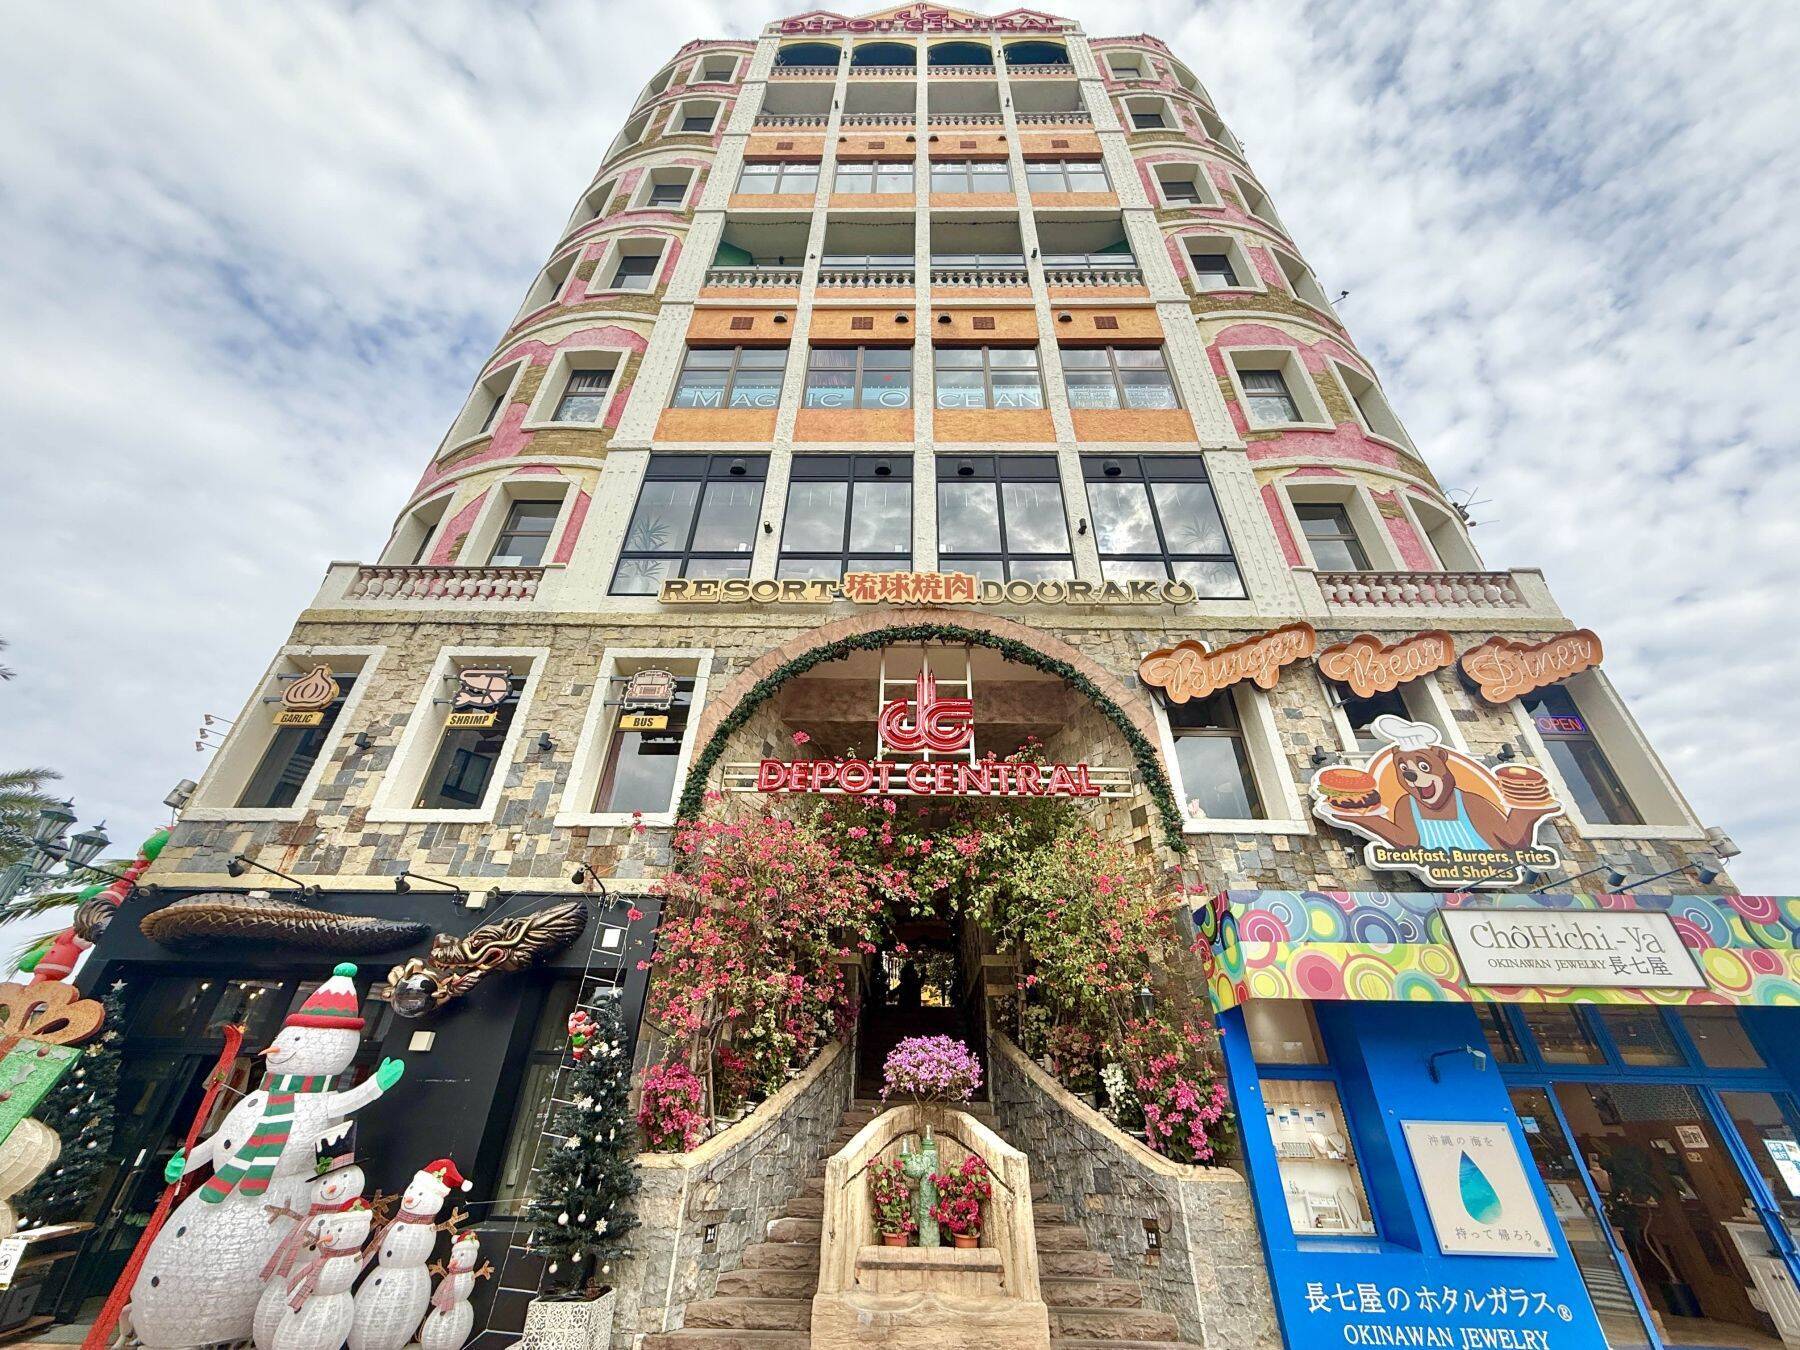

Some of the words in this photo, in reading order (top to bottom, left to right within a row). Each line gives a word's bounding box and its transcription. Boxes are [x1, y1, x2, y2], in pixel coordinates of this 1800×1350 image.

[781, 19, 895, 33] DEPOT
[904, 18, 1063, 33] CENTRAL
[691, 390, 843, 407] MAGIC
[879, 390, 1042, 408] OCEAN
[662, 580, 837, 601] RESORT
[845, 573, 975, 600] 琉球焼肉
[1149, 630, 1305, 693] Burger
[1328, 639, 1445, 688] Bear
[1471, 639, 1592, 696] Diner
[279, 714, 314, 724] GARLIC
[449, 714, 491, 726] SHRIMP
[633, 717, 654, 727] BUS
[1538, 716, 1581, 732] OPEN
[757, 759, 896, 794] DEPOT
[905, 760, 1101, 797] CENTRAL
[1376, 849, 1451, 865] Breakfast,
[1453, 849, 1514, 866] Burgers,
[1516, 850, 1551, 863] Fries
[1431, 865, 1459, 878] and
[1461, 866, 1514, 879] Shakes
[1488, 958, 1552, 969] OKINAWAN
[1553, 959, 1607, 971] JEWELRY
[1608, 956, 1673, 976] 長七屋
[1427, 1134, 1495, 1148] 沖縄の海を
[1343, 1324, 1454, 1347] OKINAWAN
[1460, 1327, 1550, 1350] JEWELRY
